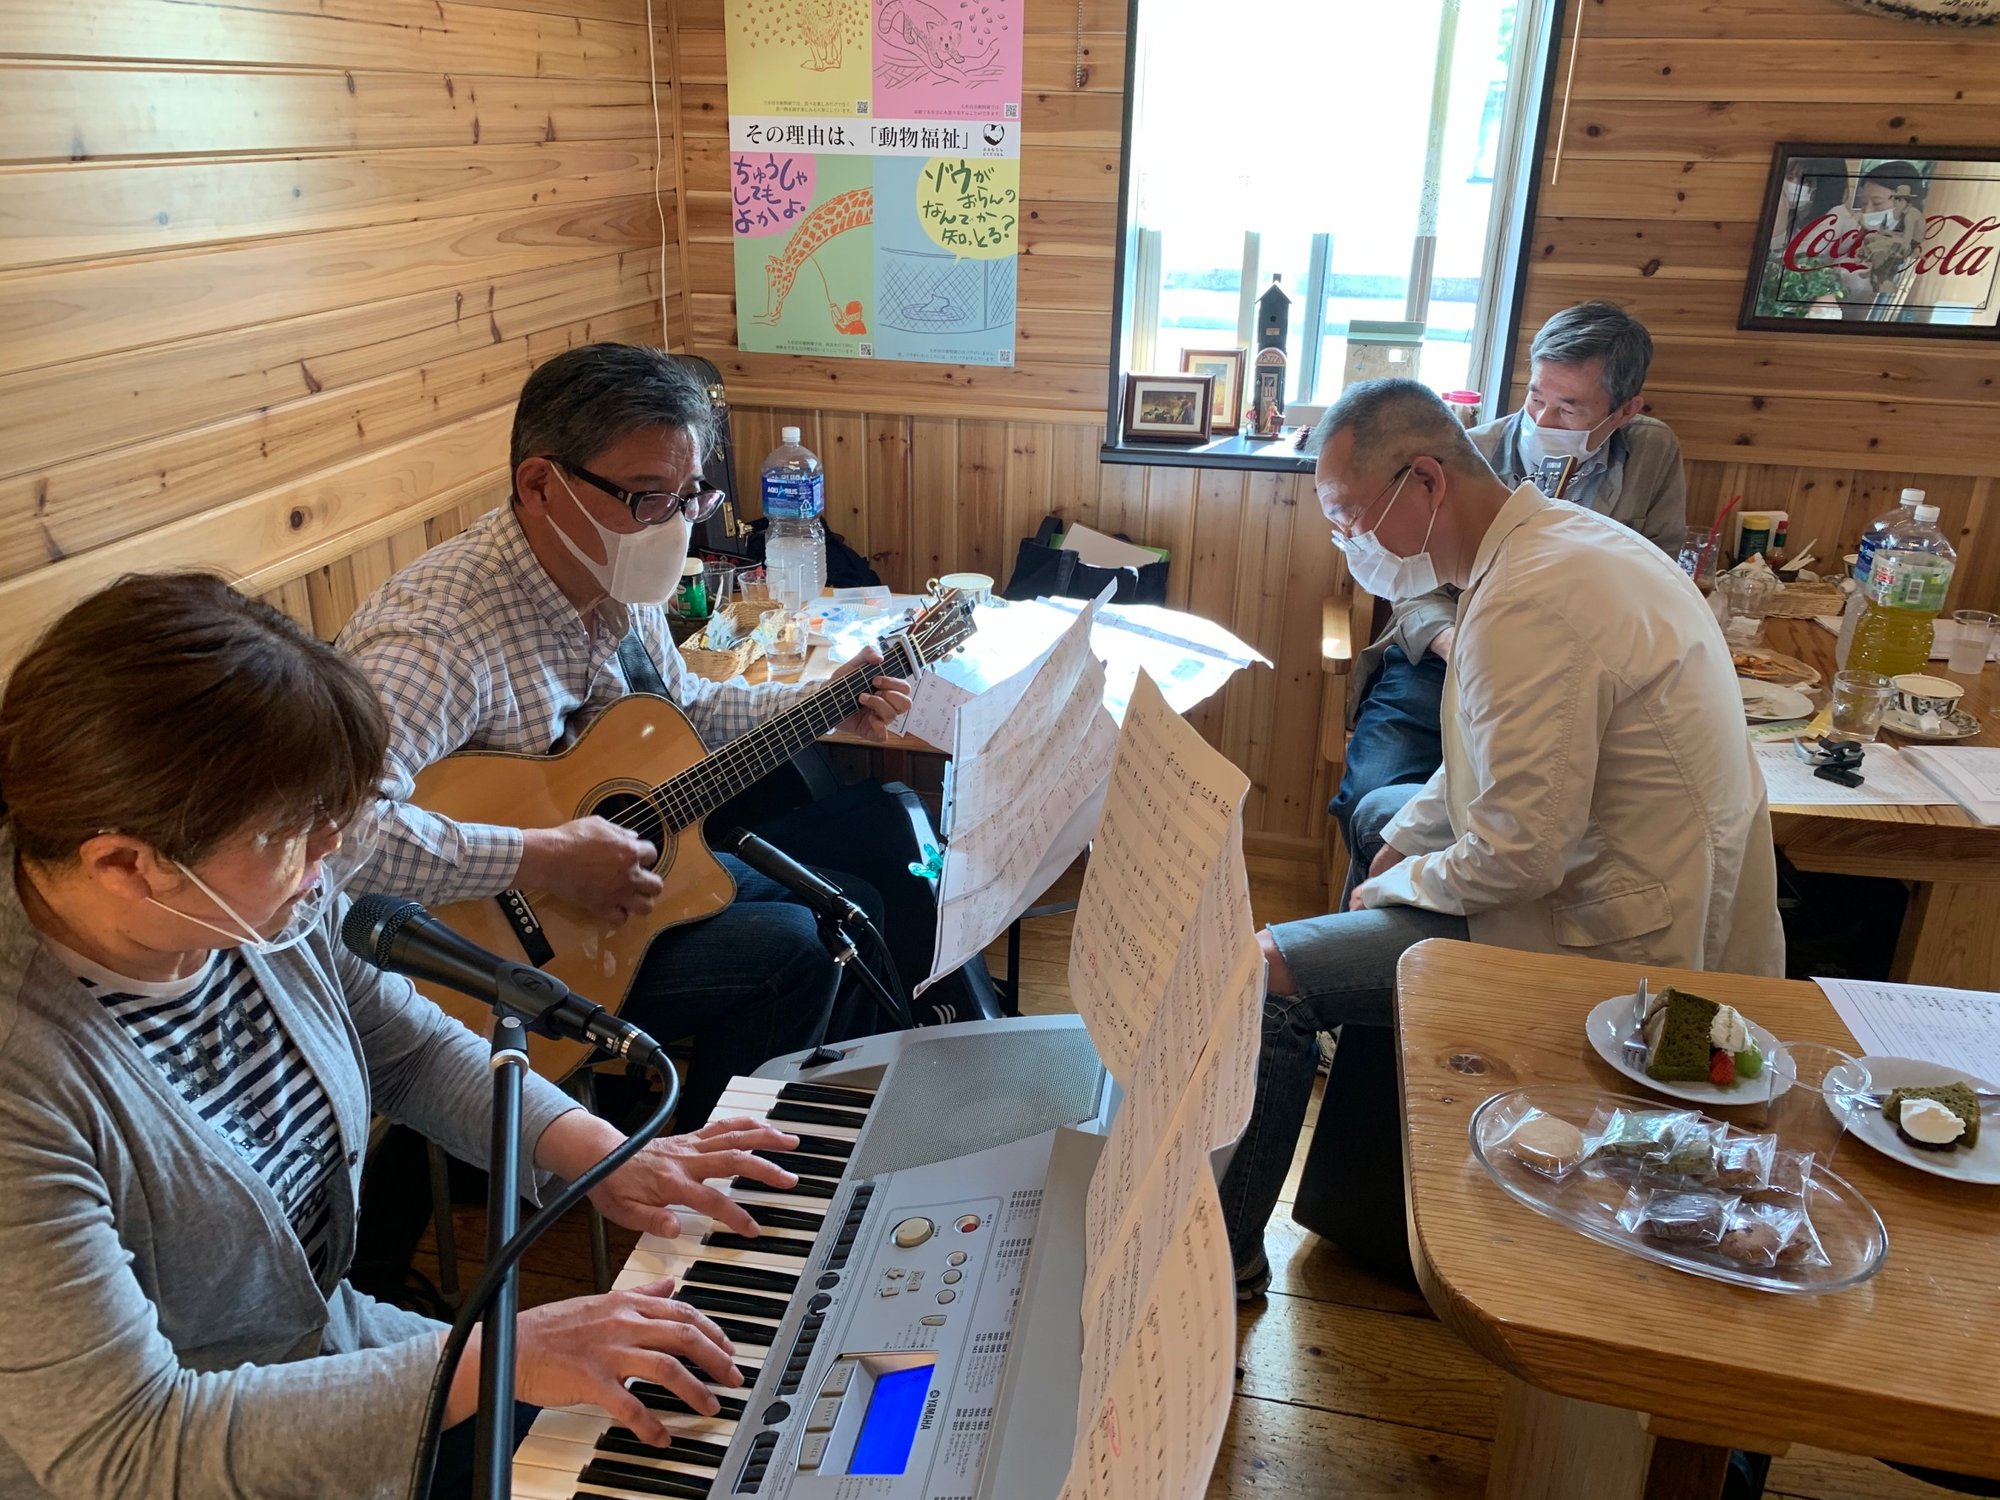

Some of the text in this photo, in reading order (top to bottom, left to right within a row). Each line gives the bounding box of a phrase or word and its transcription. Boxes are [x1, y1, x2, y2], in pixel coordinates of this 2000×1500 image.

[745, 123, 970, 150] その理由は、「動物福祉」
[734, 153, 808, 191] ちゅうしゃ
[925, 159, 994, 194] ゾウが
[734, 184, 782, 206] しても
[957, 186, 1016, 210] おらんの
[923, 200, 998, 226] なんでか
[920, 1399, 938, 1430] YAMAHA
